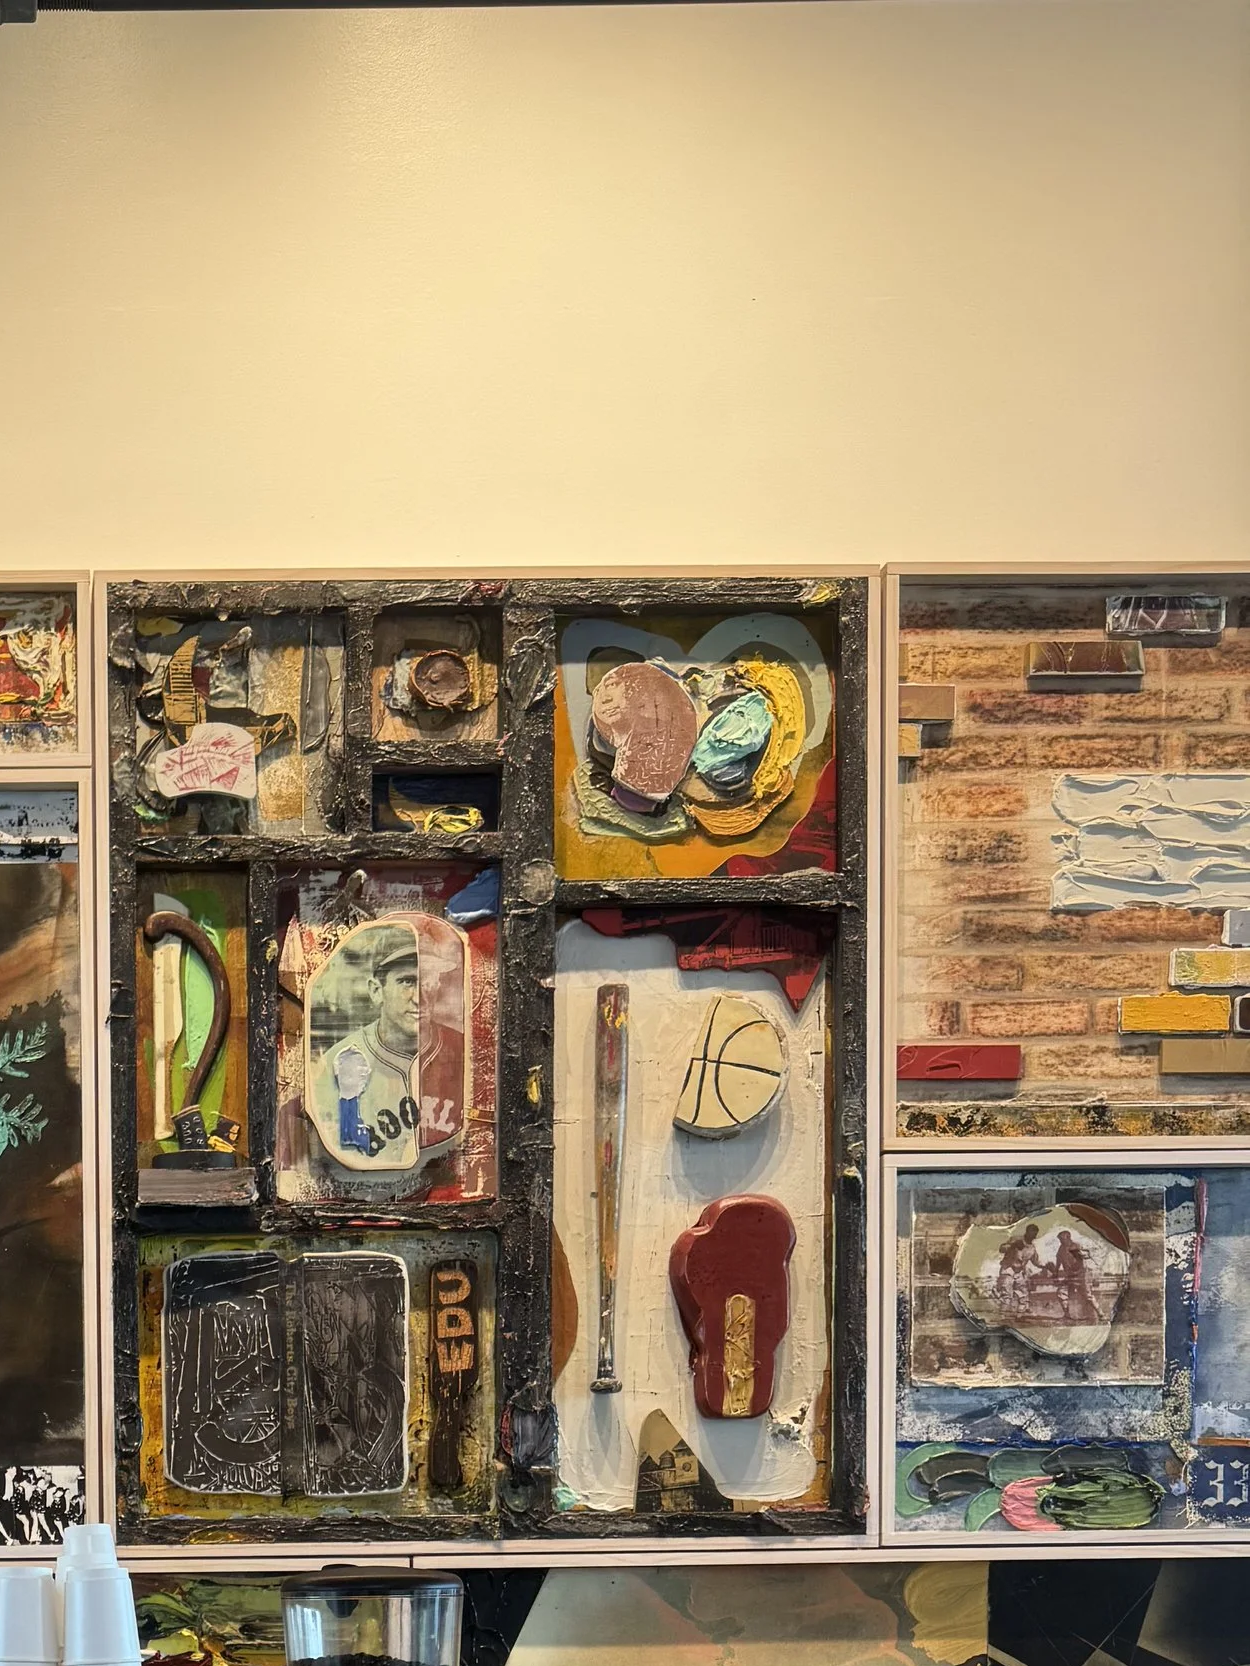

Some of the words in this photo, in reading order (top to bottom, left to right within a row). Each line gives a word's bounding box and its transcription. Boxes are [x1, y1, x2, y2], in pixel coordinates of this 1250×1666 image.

[285, 1281, 297, 1306] The
[285, 1311, 297, 1363] Roberts
[284, 1366, 298, 1394] City
[284, 1397, 298, 1430] Boys
